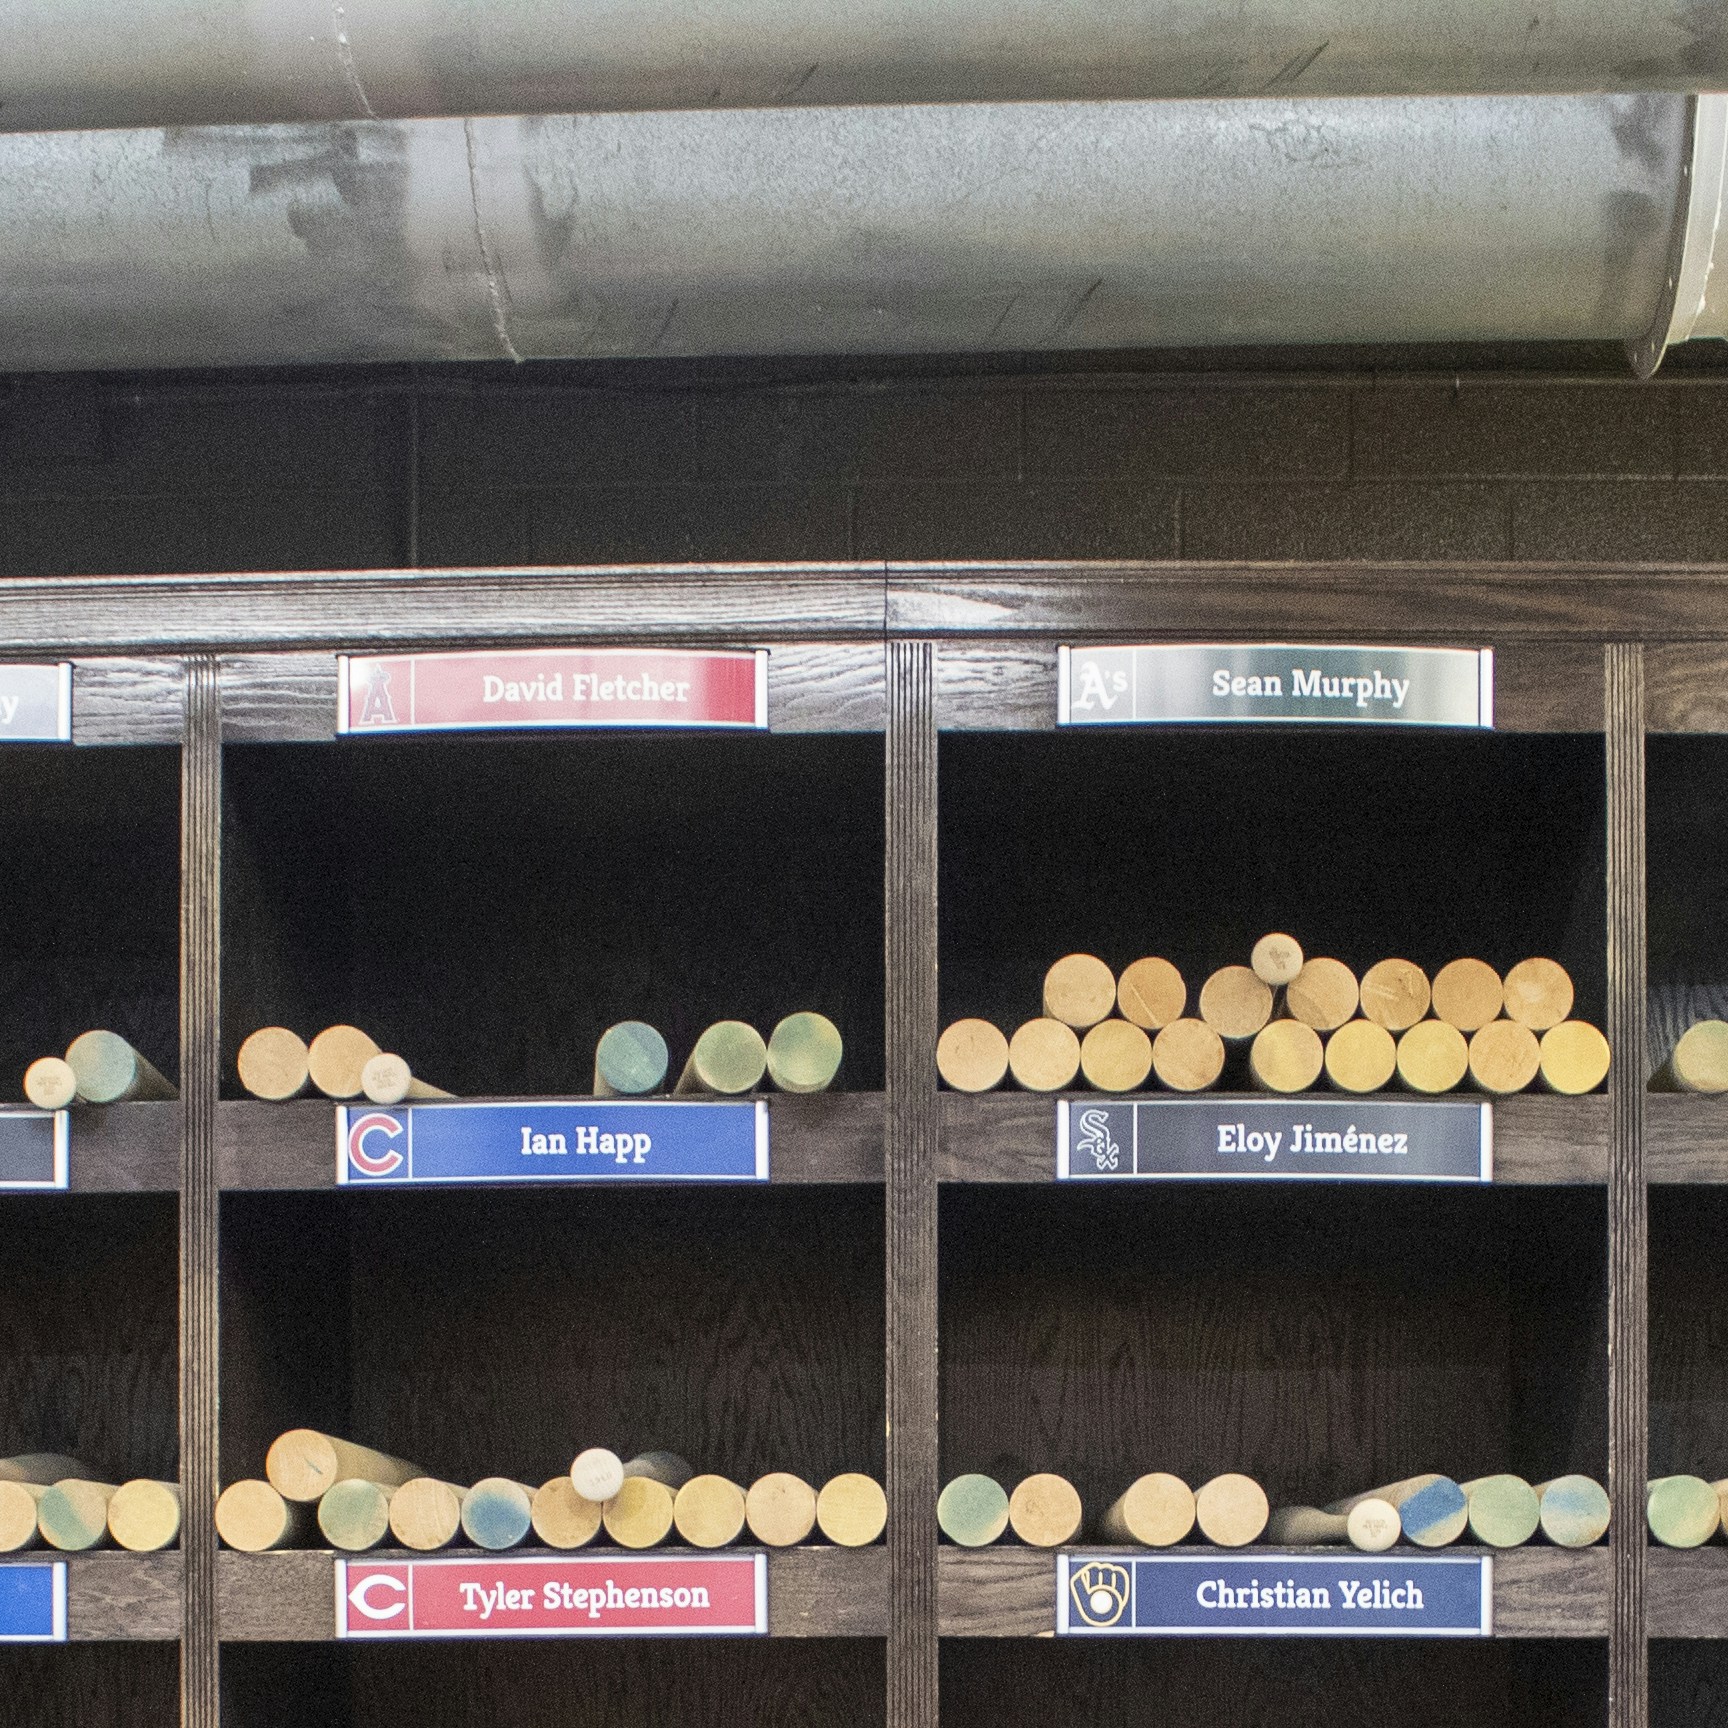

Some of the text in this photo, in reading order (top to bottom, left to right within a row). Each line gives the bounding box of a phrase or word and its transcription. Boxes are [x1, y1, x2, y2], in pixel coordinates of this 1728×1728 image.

[483, 672, 690, 702] David Fletcher
[1212, 666, 1410, 708] Sean Murphy
[348, 1113, 403, 1176] C
[521, 1127, 651, 1163] Ian Happ
[1218, 1124, 1281, 1161] Eloy
[348, 1574, 405, 1619] C
[459, 1580, 710, 1619] Tyler Stephenson
[1197, 1579, 1424, 1608] Christian Yelich
